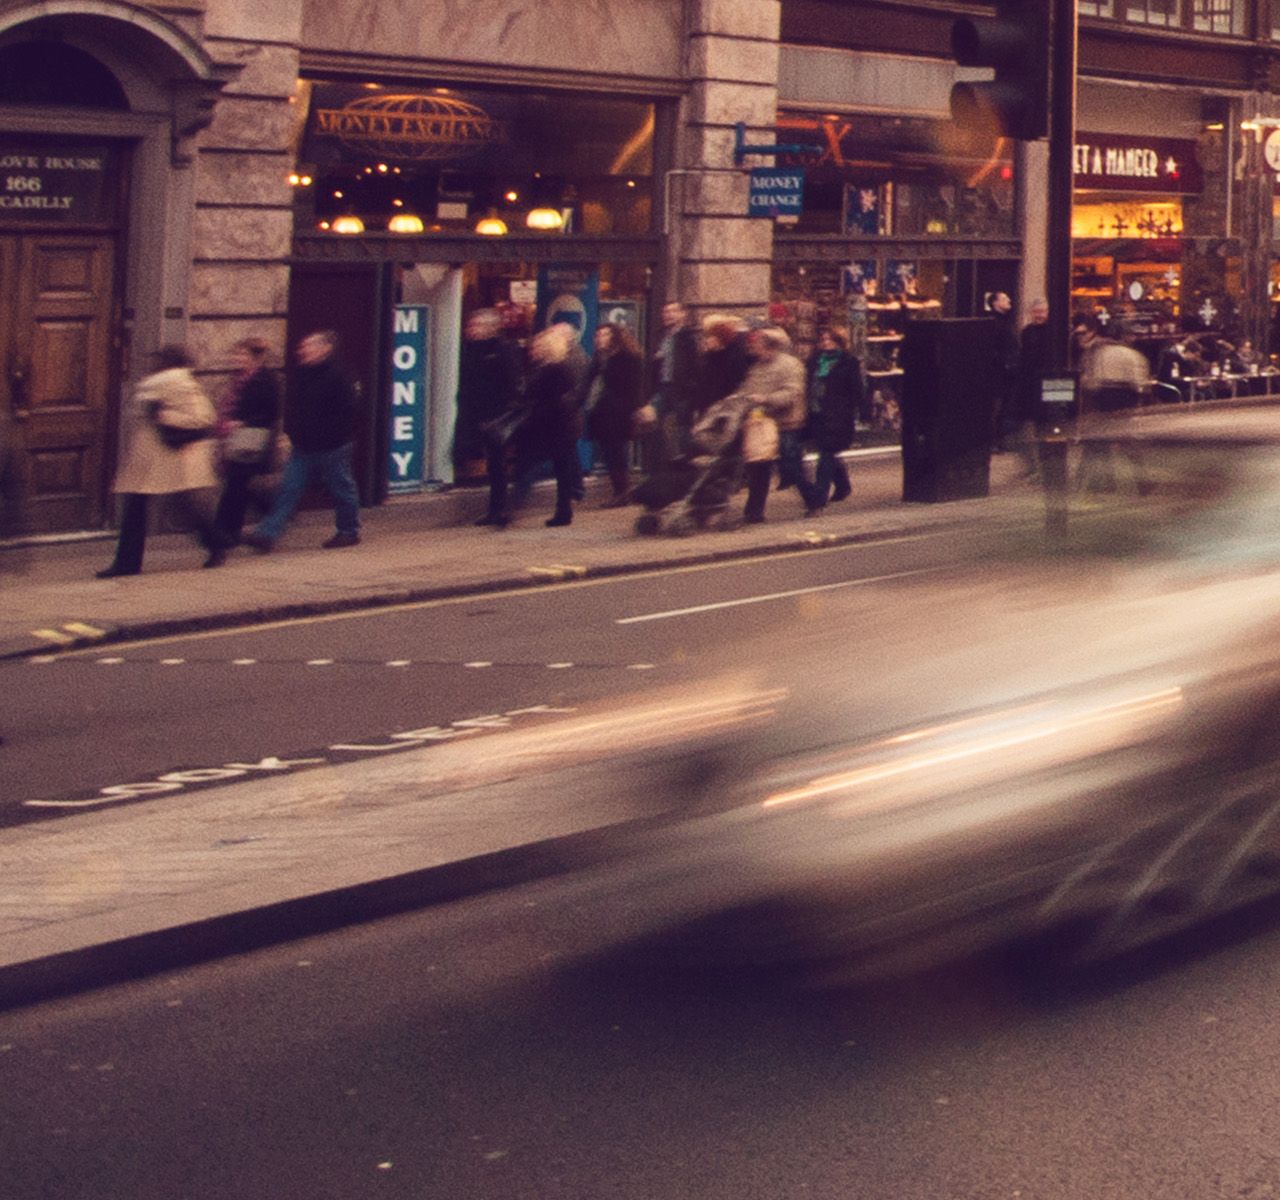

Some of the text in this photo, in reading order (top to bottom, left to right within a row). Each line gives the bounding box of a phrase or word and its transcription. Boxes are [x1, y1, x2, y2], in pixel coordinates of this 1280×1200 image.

[1091, 146, 1102, 175] A
[1105, 147, 1158, 177] MANGER
[6, 176, 42, 192] 166
[752, 175, 803, 189] MONEY
[751, 193, 802, 207] CHANGE
[391, 308, 418, 478] MONEY
[22, 704, 579, 807] LOOK LEFT
